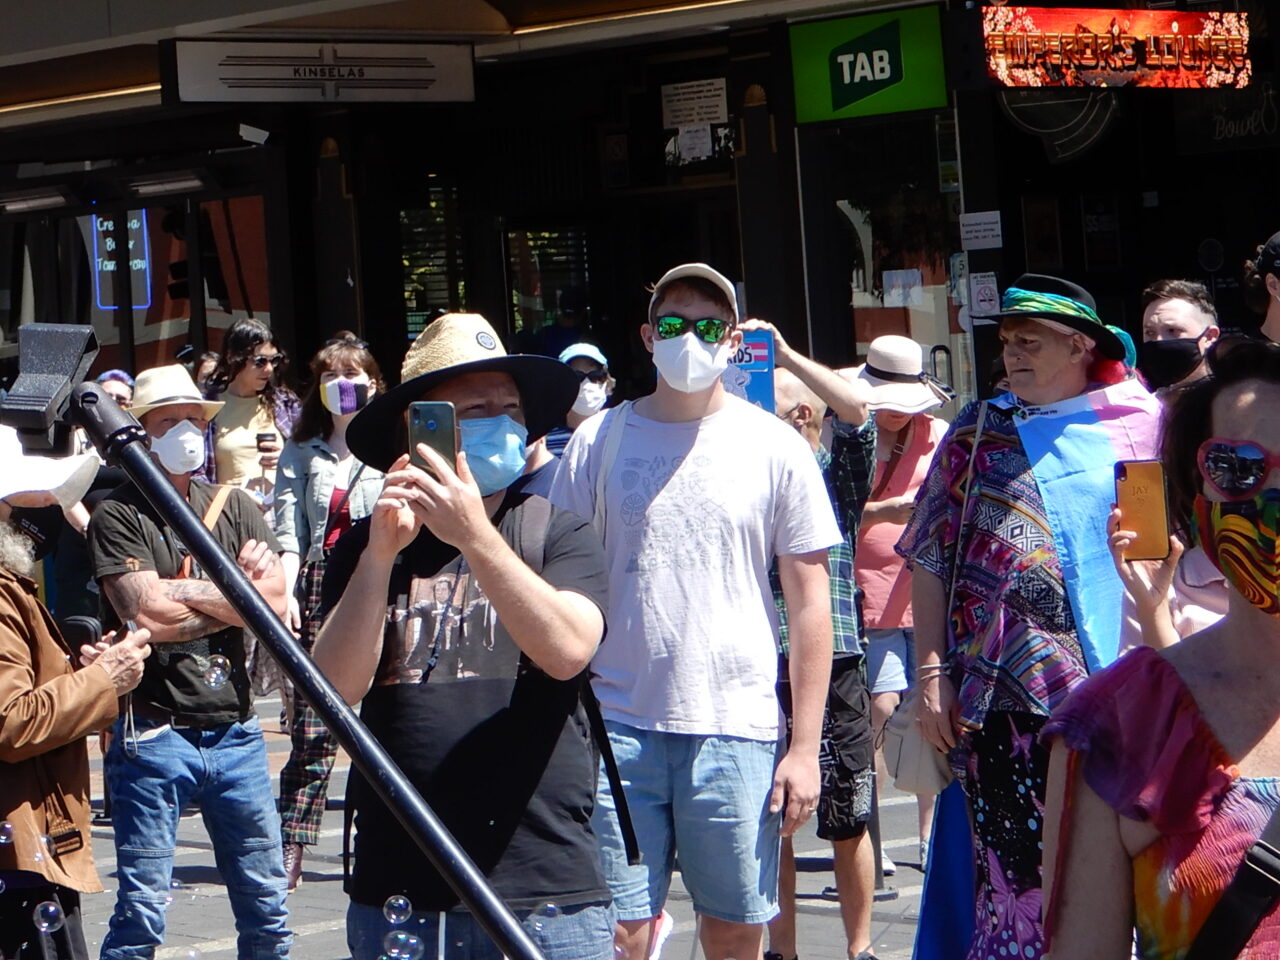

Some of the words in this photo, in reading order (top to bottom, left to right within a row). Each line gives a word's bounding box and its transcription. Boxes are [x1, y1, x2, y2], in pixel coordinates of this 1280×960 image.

[837, 50, 891, 84] TAB
[987, 31, 1138, 69] EMPEROR'S
[1145, 34, 1245, 68] LOUNGE
[292, 67, 365, 78] KINSELAS
